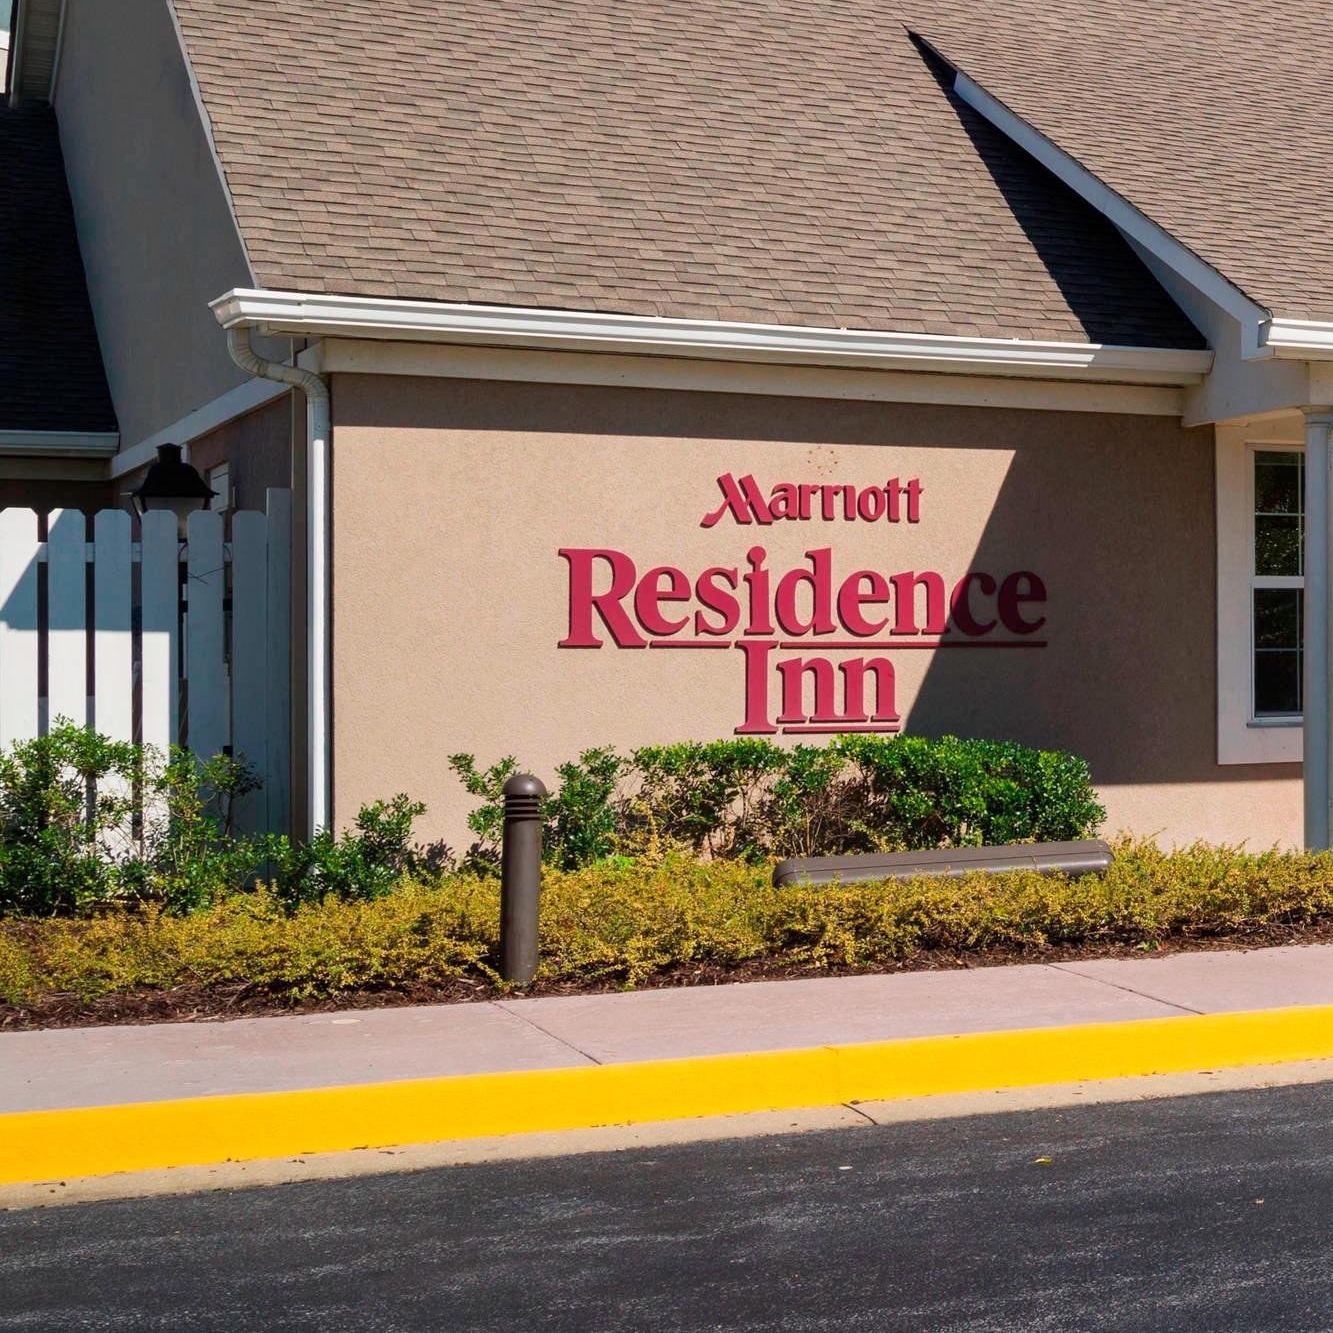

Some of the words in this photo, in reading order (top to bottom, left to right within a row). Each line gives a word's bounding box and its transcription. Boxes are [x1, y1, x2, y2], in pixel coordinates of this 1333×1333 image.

[700, 473, 924, 528] Marriott
[558, 546, 1047, 649] Residence
[734, 640, 901, 734] Inn
